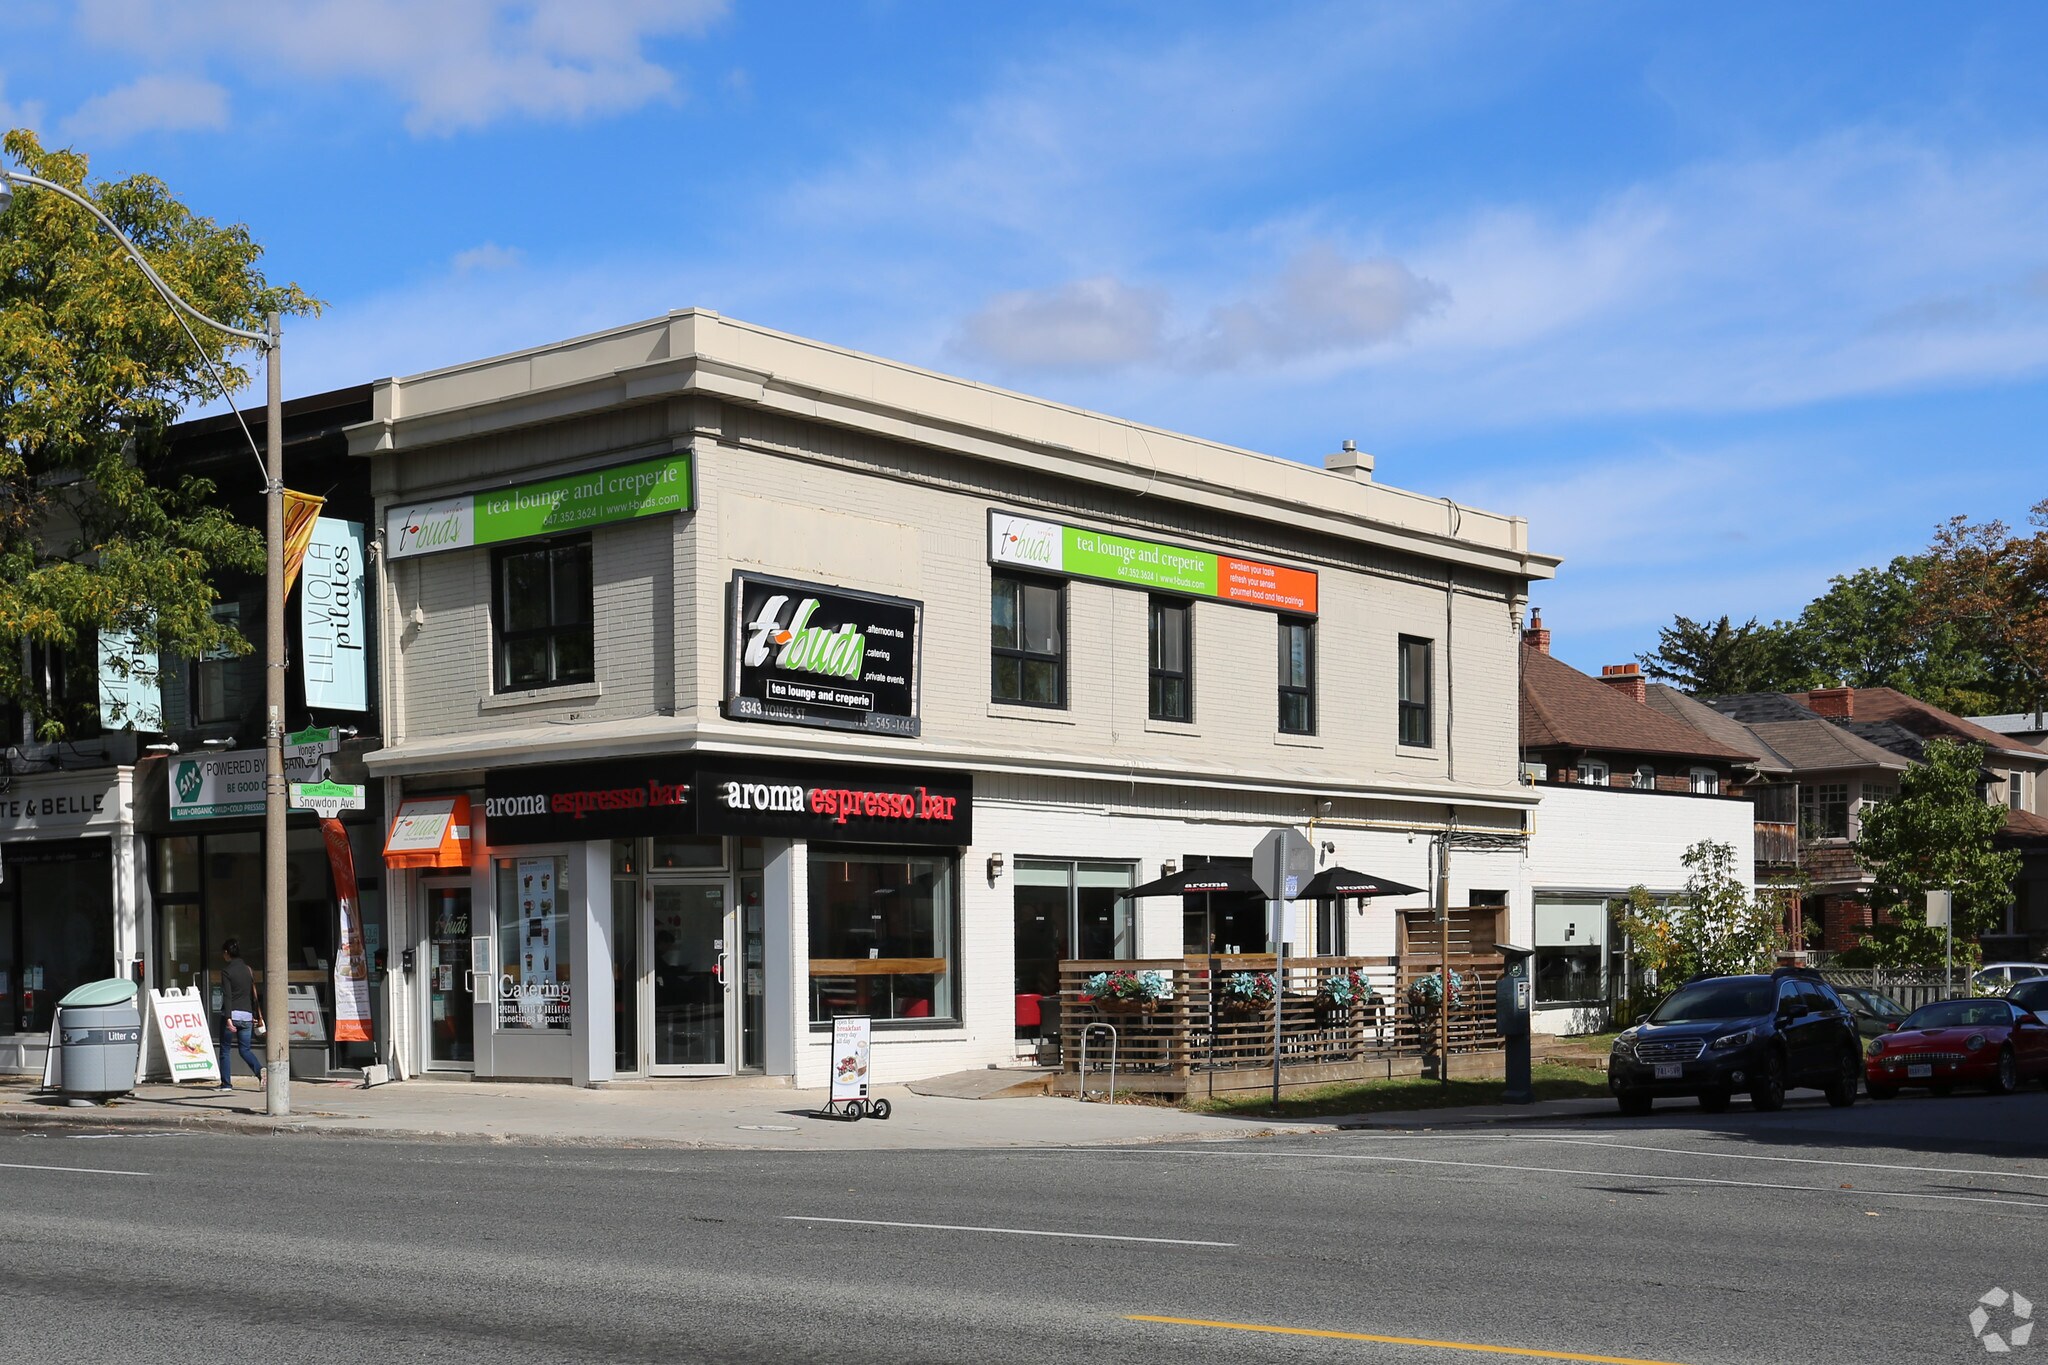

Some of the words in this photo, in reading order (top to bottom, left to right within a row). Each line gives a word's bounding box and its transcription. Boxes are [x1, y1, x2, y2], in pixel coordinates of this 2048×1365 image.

[487, 499, 509, 515] tea
[515, 487, 569, 511] lounge
[574, 476, 604, 499] and
[609, 464, 677, 495] creperie
[543, 507, 597, 526] 647.352.3624
[1077, 536, 1094, 552] tea
[1097, 536, 1136, 564] lounge
[1138, 547, 1159, 564] and
[1162, 556, 1204, 574] creperie
[1118, 566, 1154, 581] 647.352.3624
[1230, 562, 1250, 572] awaken
[1251, 567, 1261, 575] your
[1262, 567, 1275, 576] taste
[307, 542, 332, 626] VIOLA
[1230, 574, 1247, 584] refresh
[1248, 578, 1259, 586] your
[1260, 580, 1276, 589] senses
[328, 545, 362, 650] pilates
[1230, 587, 1252, 596] gourmet
[1252, 589, 1264, 599] food
[1265, 592, 1275, 600] and
[1276, 594, 1284, 602] tea
[1285, 595, 1304, 607] pairings
[895, 629, 904, 639] tea
[308, 635, 334, 684] LILI
[887, 676, 905, 685] events
[771, 683, 786, 695] tea
[788, 684, 816, 701] lounge
[818, 690, 834, 702] and
[836, 690, 870, 706] creperie
[740, 701, 762, 714] 3343
[763, 703, 794, 718] YONGE
[796, 708, 806, 720] ST
[876, 717, 891, 729] 545
[298, 744, 316, 757] Yonge
[318, 743, 324, 753] St
[206, 760, 252, 776] POWERED
[255, 759, 266, 773] BY
[227, 783, 235, 793] BE
[238, 781, 259, 793] GOOD
[303, 784, 322, 794] Yonge
[323, 784, 353, 795] Lawrence
[25, 800, 37, 819] &
[42, 794, 104, 815] BELLE
[244, 803, 265, 811] PRESSED
[300, 796, 337, 808] Snowdon
[340, 798, 355, 808] Ave
[485, 794, 546, 817] aroma
[551, 786, 643, 819] espresso
[649, 780, 686, 805] bar
[727, 781, 805, 812] aroma
[810, 787, 915, 823] espresso
[919, 787, 956, 820] bar
[499, 974, 571, 1002] Catering
[499, 1005, 518, 1014] SPECIAL
[545, 1005, 571, 1014] BREAKFAS
[164, 1013, 202, 1029] OPEN
[499, 1014, 536, 1025] meetings
[545, 1014, 571, 1026] partie
[108, 1031, 127, 1041] Litter
